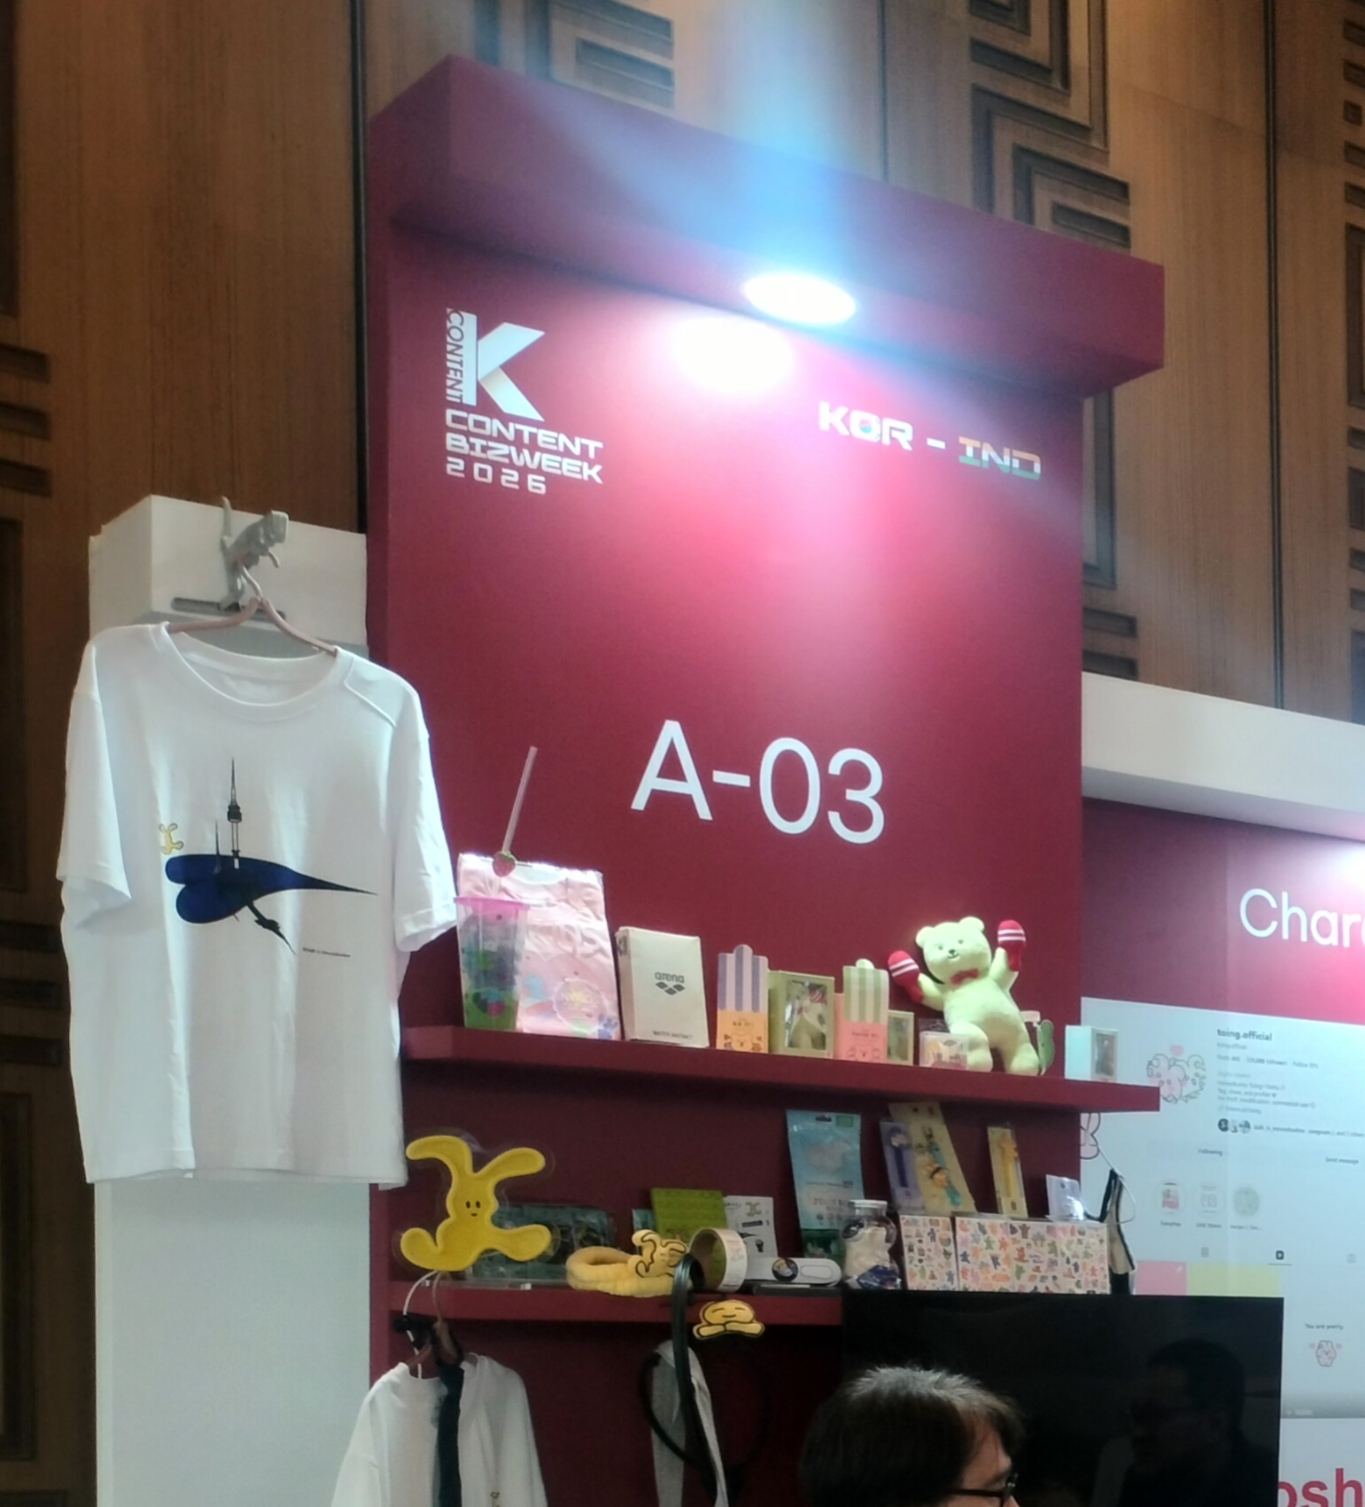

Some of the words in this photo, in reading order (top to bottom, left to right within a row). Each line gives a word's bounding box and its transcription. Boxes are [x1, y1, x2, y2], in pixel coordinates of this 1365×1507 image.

[446, 408, 603, 459] CONTENT
[446, 432, 603, 484] BIZWEEK
[818, 401, 914, 452] KOR
[958, 435, 1042, 481] IND
[446, 457, 546, 494] 2026
[630, 719, 885, 844] A-03
[654, 971, 685, 984] arena
